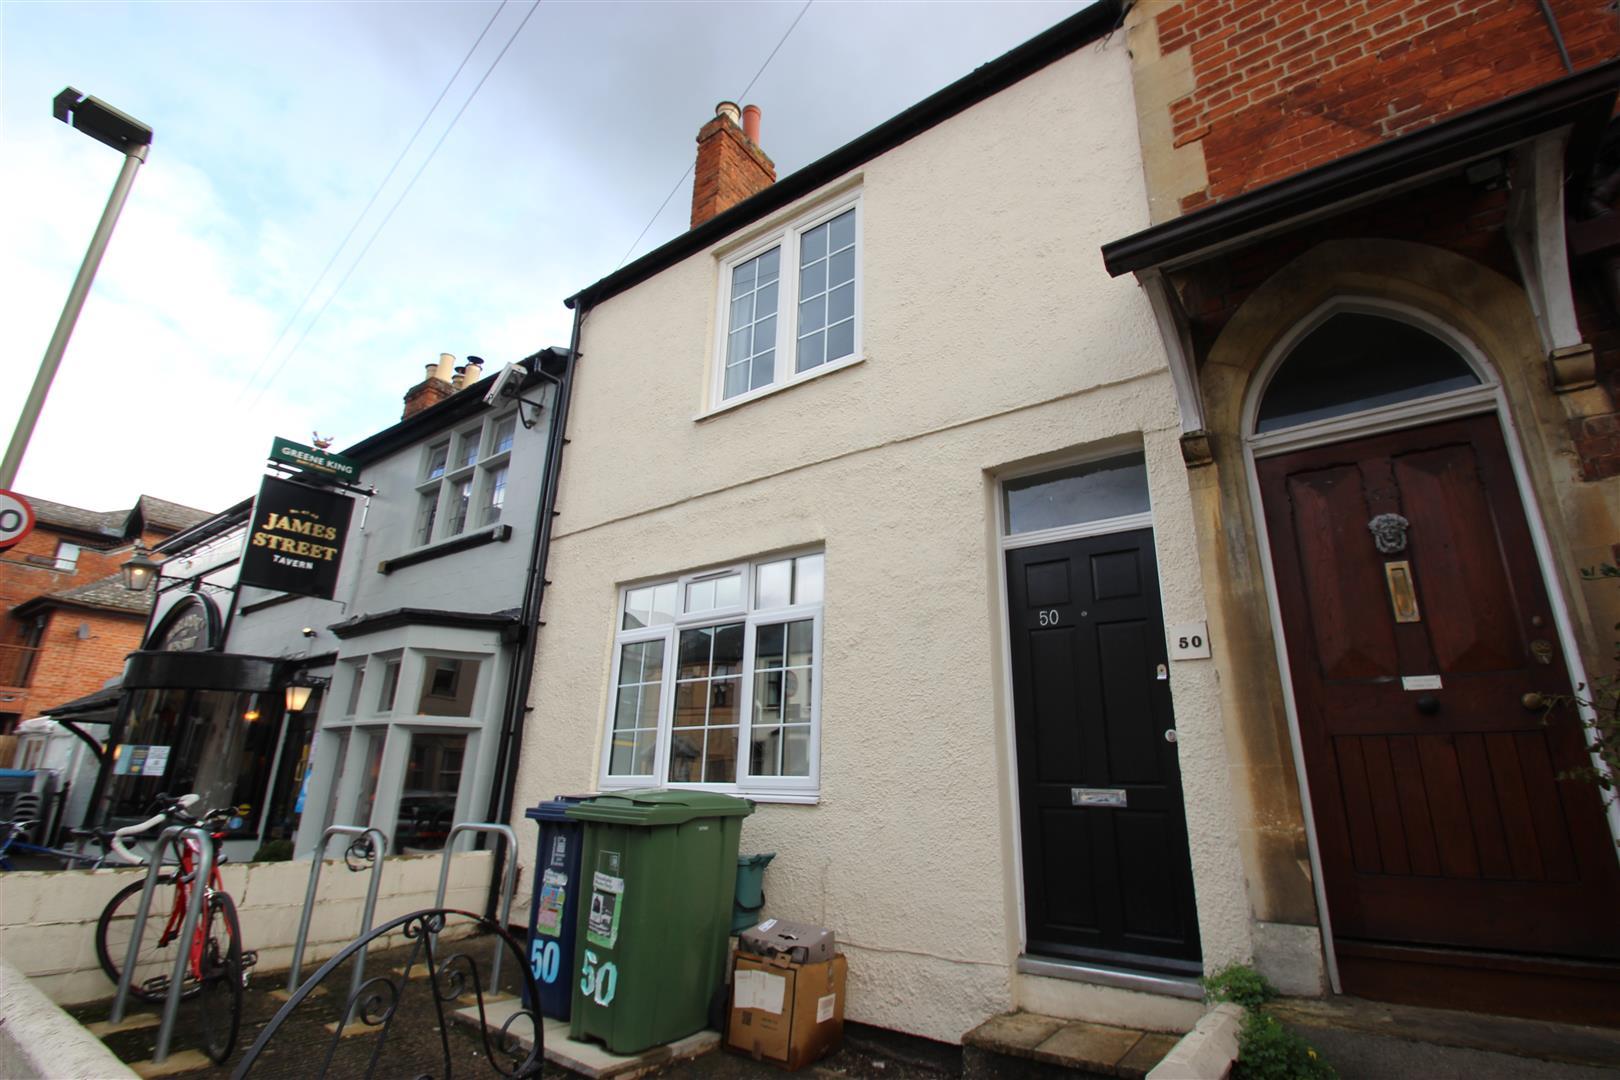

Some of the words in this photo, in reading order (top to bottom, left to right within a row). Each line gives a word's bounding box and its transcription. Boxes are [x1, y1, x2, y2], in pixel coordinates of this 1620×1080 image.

[281, 447, 325, 465] GREENE
[326, 460, 353, 474] KING
[262, 513, 337, 541] JAMES
[253, 532, 337, 561] STREET
[273, 554, 314, 570] TAVERN
[1039, 609, 1059, 626] 50
[1179, 635, 1202, 649] 50
[531, 939, 560, 983] 50
[580, 949, 618, 1007] 50
